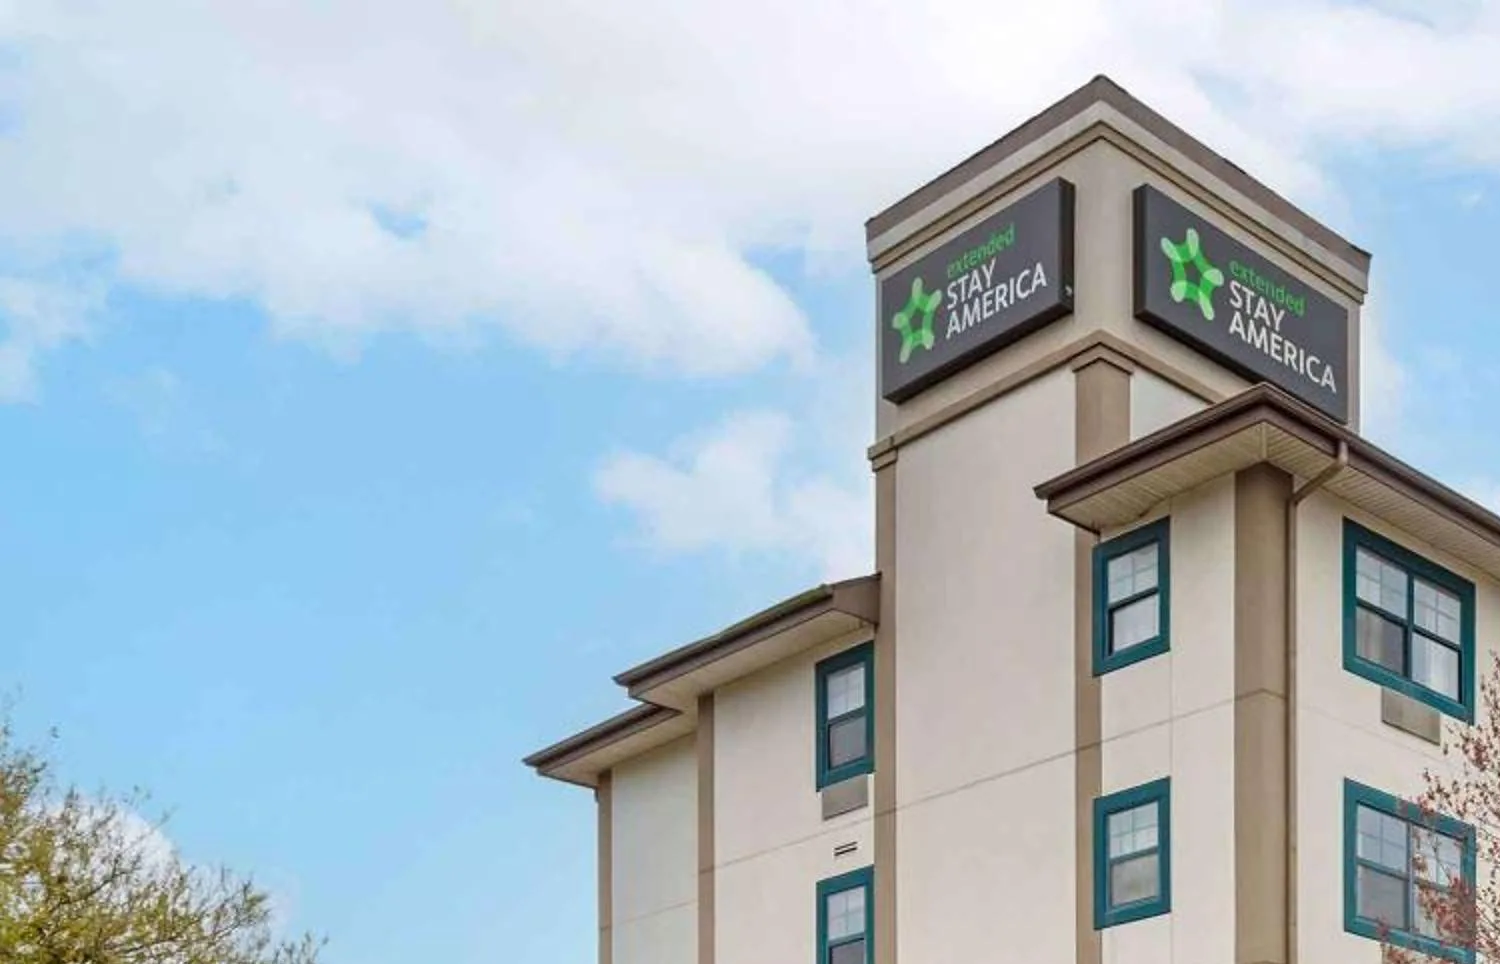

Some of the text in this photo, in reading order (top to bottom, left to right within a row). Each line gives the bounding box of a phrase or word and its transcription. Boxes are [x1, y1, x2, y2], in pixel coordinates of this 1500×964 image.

[946, 261, 1048, 340] AMERICA
[947, 257, 997, 310] STAY
[1229, 280, 1285, 332] STAY
[1228, 311, 1337, 393] AMERICA
